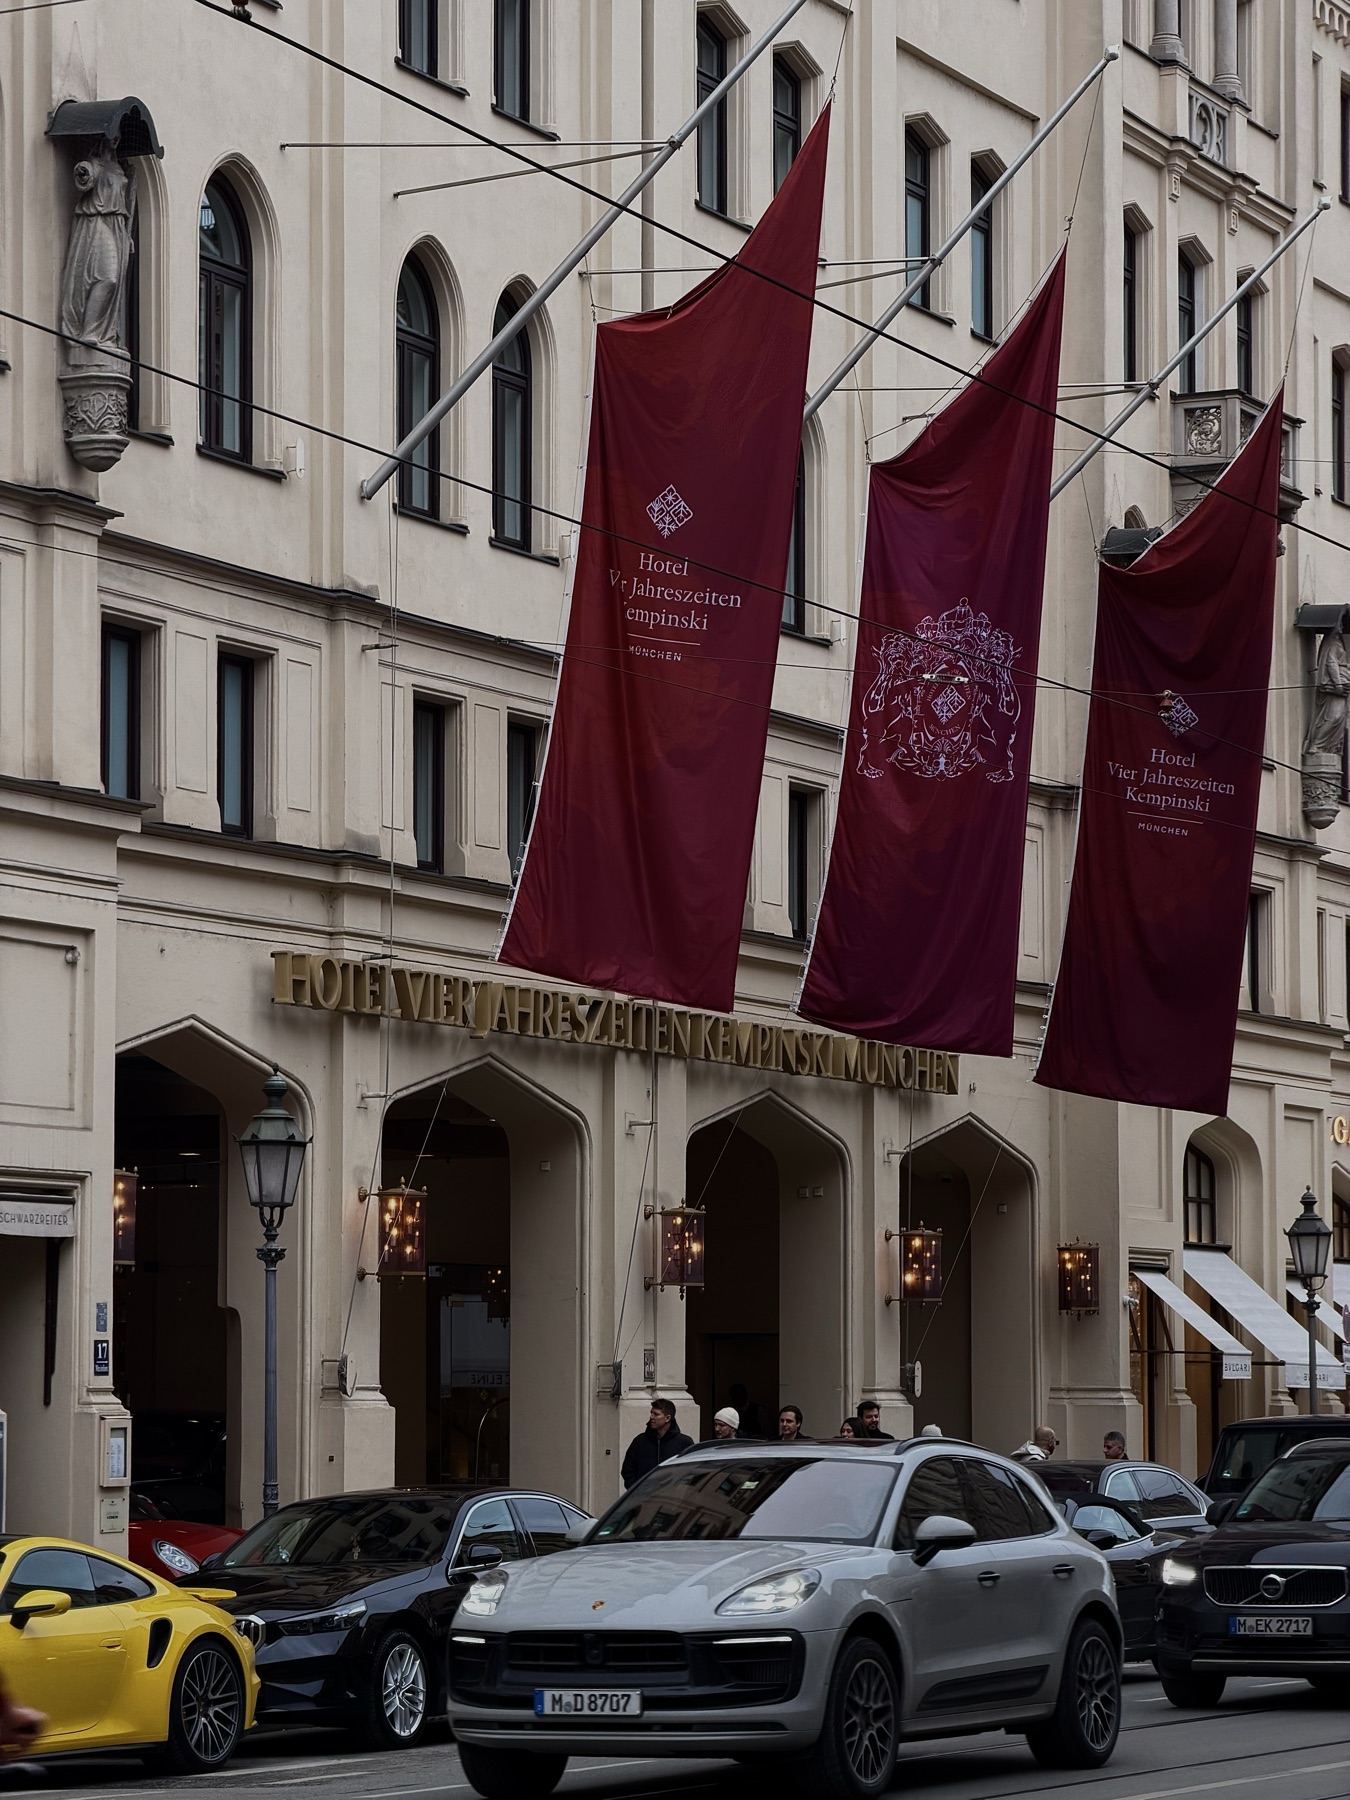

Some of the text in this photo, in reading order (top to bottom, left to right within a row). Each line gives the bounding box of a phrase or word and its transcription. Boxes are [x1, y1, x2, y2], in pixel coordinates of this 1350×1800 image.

[639, 552, 689, 577] Hotel
[608, 569, 742, 608] Vr Jahreszeiten
[624, 601, 709, 631] empinski
[629, 645, 682, 662] MÜNCHEN
[1150, 748, 1196, 768] Hotel
[1107, 761, 1235, 795] Vier Jahreszeiten
[1125, 786, 1210, 813] Kempinski
[1137, 822, 1189, 836] MÜNCHEN
[271, 950, 402, 1018] HOTEL
[392, 968, 476, 1029] VIER
[469, 980, 691, 1058] JAHRESZEITEN
[690, 1012, 834, 1077] KEMPINSKI
[0, 1212, 69, 1226] SCHWARZREITER
[97, 1342, 108, 1359] 17
